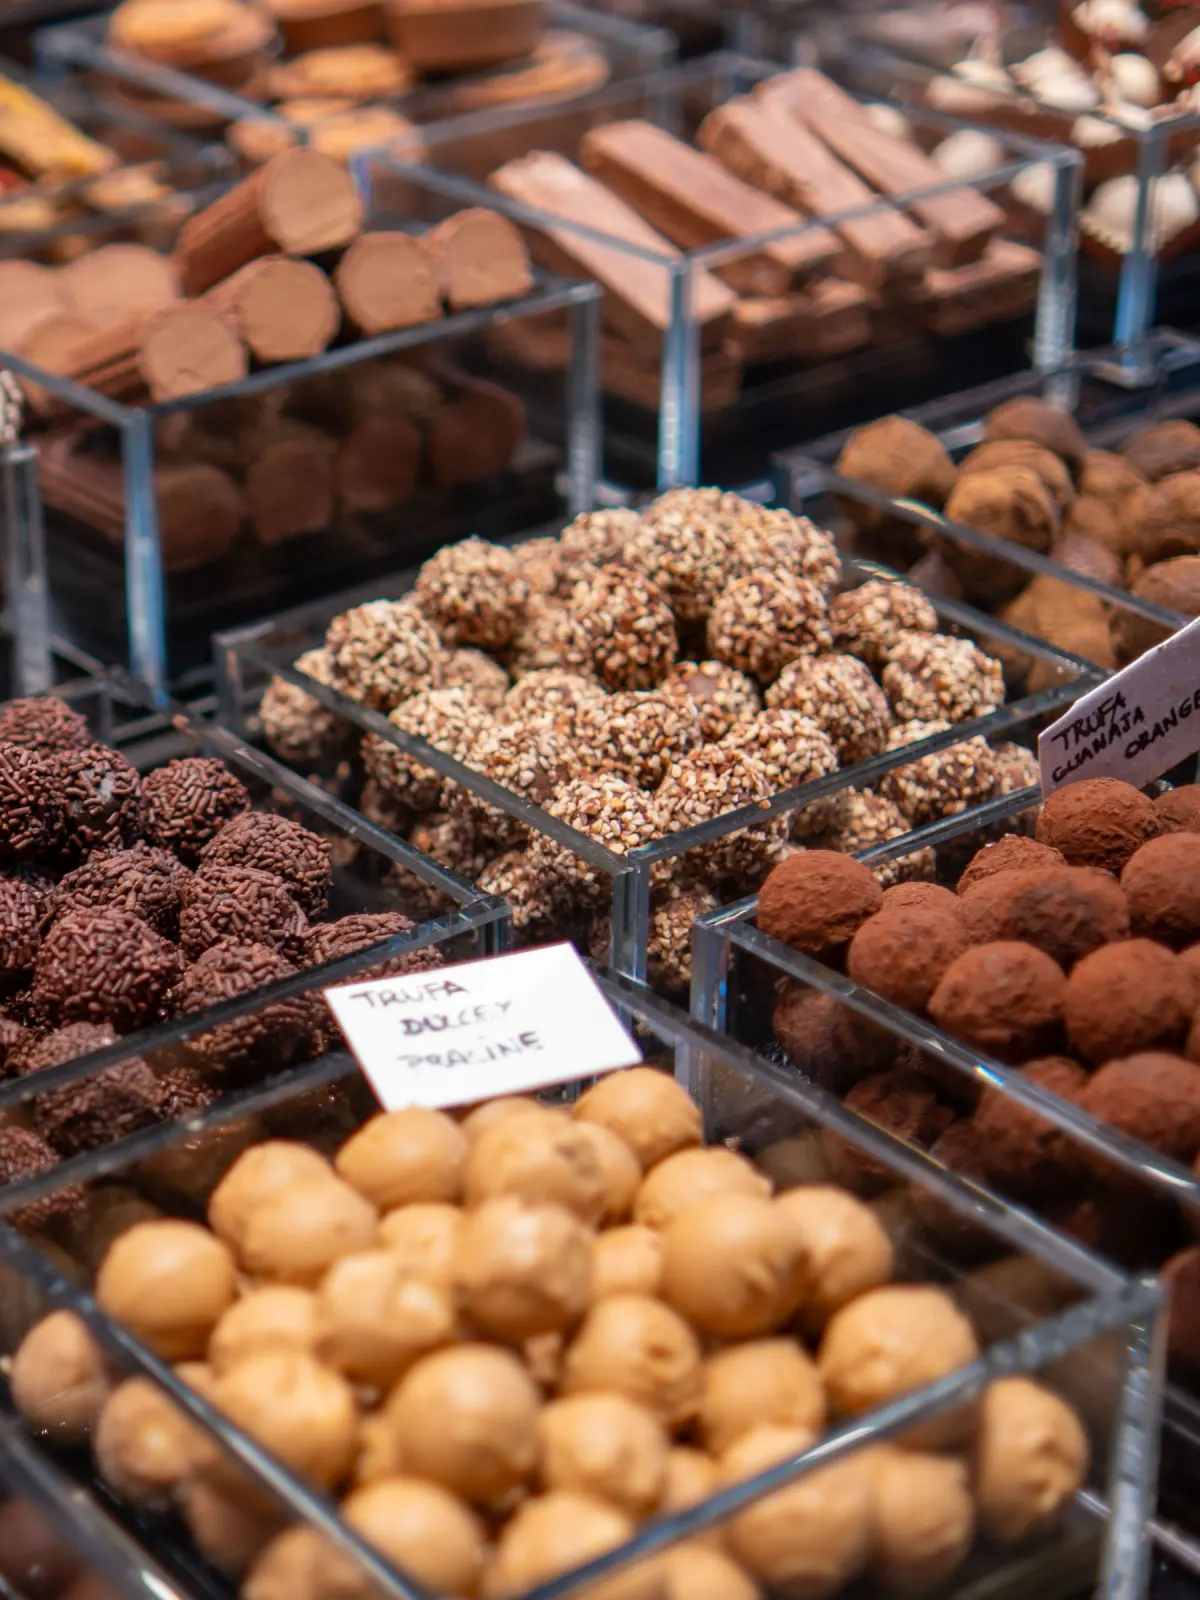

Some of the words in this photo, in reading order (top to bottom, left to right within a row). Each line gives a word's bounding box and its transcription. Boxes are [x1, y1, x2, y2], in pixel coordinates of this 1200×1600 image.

[1051, 691, 1128, 750] TRUFA
[1052, 706, 1145, 783] GUANAJA
[351, 980, 469, 1008] TRUFA
